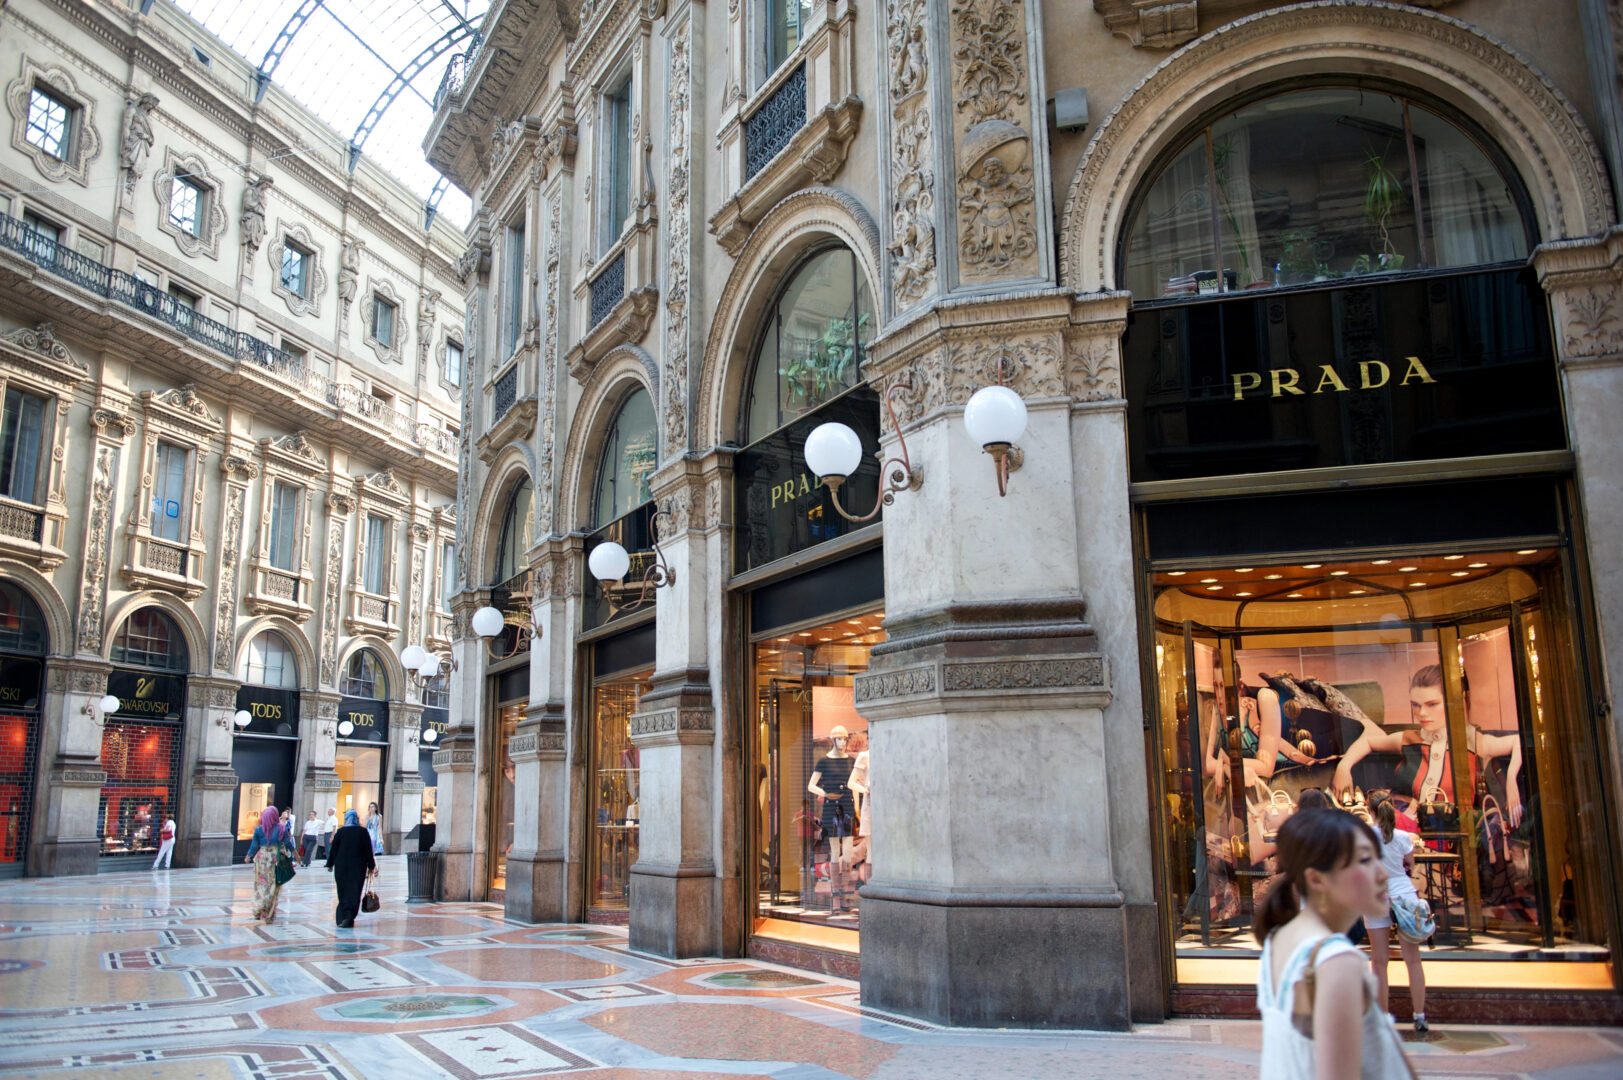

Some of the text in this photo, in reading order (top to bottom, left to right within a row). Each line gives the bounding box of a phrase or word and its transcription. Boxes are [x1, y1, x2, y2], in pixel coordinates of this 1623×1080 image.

[1230, 356, 1439, 401] PRADA
[118, 697, 169, 714] SWAROVSKI
[250, 702, 282, 719] TOD'S
[348, 711, 375, 727] TOD'S
